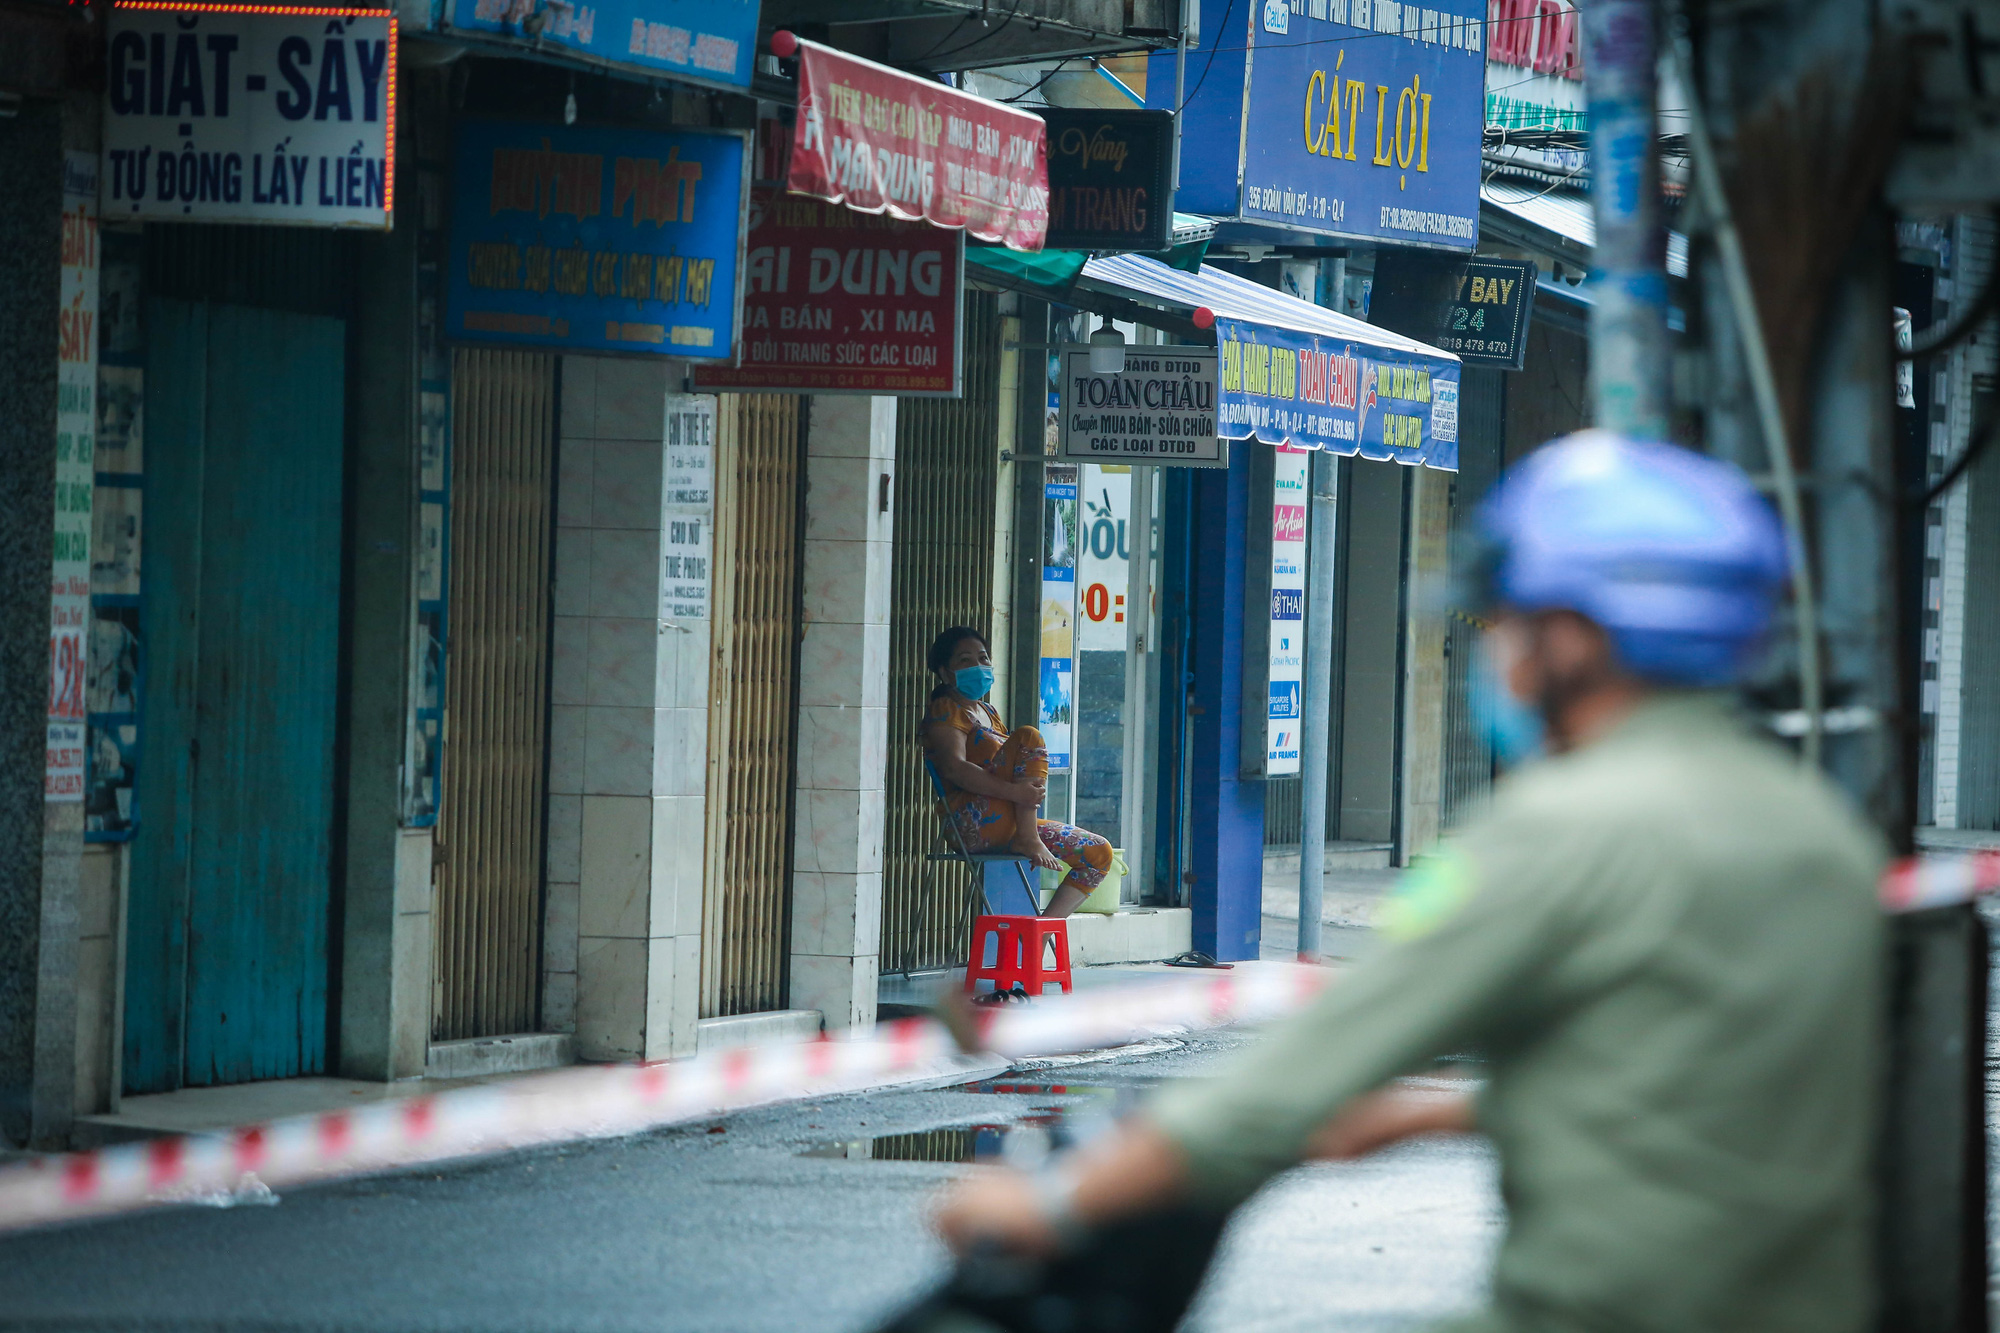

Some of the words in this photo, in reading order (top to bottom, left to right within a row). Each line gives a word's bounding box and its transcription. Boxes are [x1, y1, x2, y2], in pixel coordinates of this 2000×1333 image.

[110, 14, 239, 137] GIẶT
[276, 10, 387, 123] SẤY
[891, 101, 917, 140] CAO
[948, 115, 974, 154] MUA
[1304, 49, 1365, 161] CÁT
[1373, 74, 1432, 191] LỢI
[110, 144, 151, 213] TỰ
[156, 140, 242, 214] ĐỘNG
[253, 136, 308, 206] LẤY
[319, 139, 387, 209] LIỀN
[612, 145, 701, 229] PHÁT
[875, 147, 935, 209] DUNG
[1071, 187, 1147, 233] TRANG
[1248, 186, 1261, 210] 356
[1262, 184, 1281, 213] ĐOÀN
[1283, 187, 1296, 216] VĂN
[1296, 192, 1308, 217] BƠ
[1312, 196, 1326, 219] P.10
[1332, 199, 1345, 223] Q.4
[61, 204, 98, 283] GIẶT
[747, 245, 791, 294] AI
[808, 247, 942, 297] DUNG
[1470, 276, 1514, 305] BAY
[59, 290, 93, 362] SẤY
[780, 303, 833, 331] BÁN
[859, 308, 885, 331] XI
[896, 310, 936, 338] MẠ
[782, 343, 831, 364] TRANG
[835, 340, 866, 365] SỨC
[869, 342, 900, 366] CÁC
[903, 345, 938, 370] LOẠI
[1465, 339, 1484, 352] 478
[1487, 340, 1507, 354] 470
[1074, 373, 1143, 409] TOÀN
[1143, 374, 1214, 411] CHÂU
[1299, 338, 1327, 404] TOÀN
[1329, 345, 1358, 411] CHÂU
[1072, 413, 1098, 435] Chuyên
[1100, 415, 1127, 434] MUA
[1128, 413, 1152, 435] BÁN
[1158, 412, 1181, 436] SỬA
[1183, 414, 1213, 437] CHỮA
[1090, 436, 1119, 451] CÁC
[1123, 439, 1154, 454] LOẠI
[1158, 441, 1196, 453] ĐTDĐ
[1282, 596, 1302, 614] THAI
[1278, 750, 1298, 759] FRANCE
